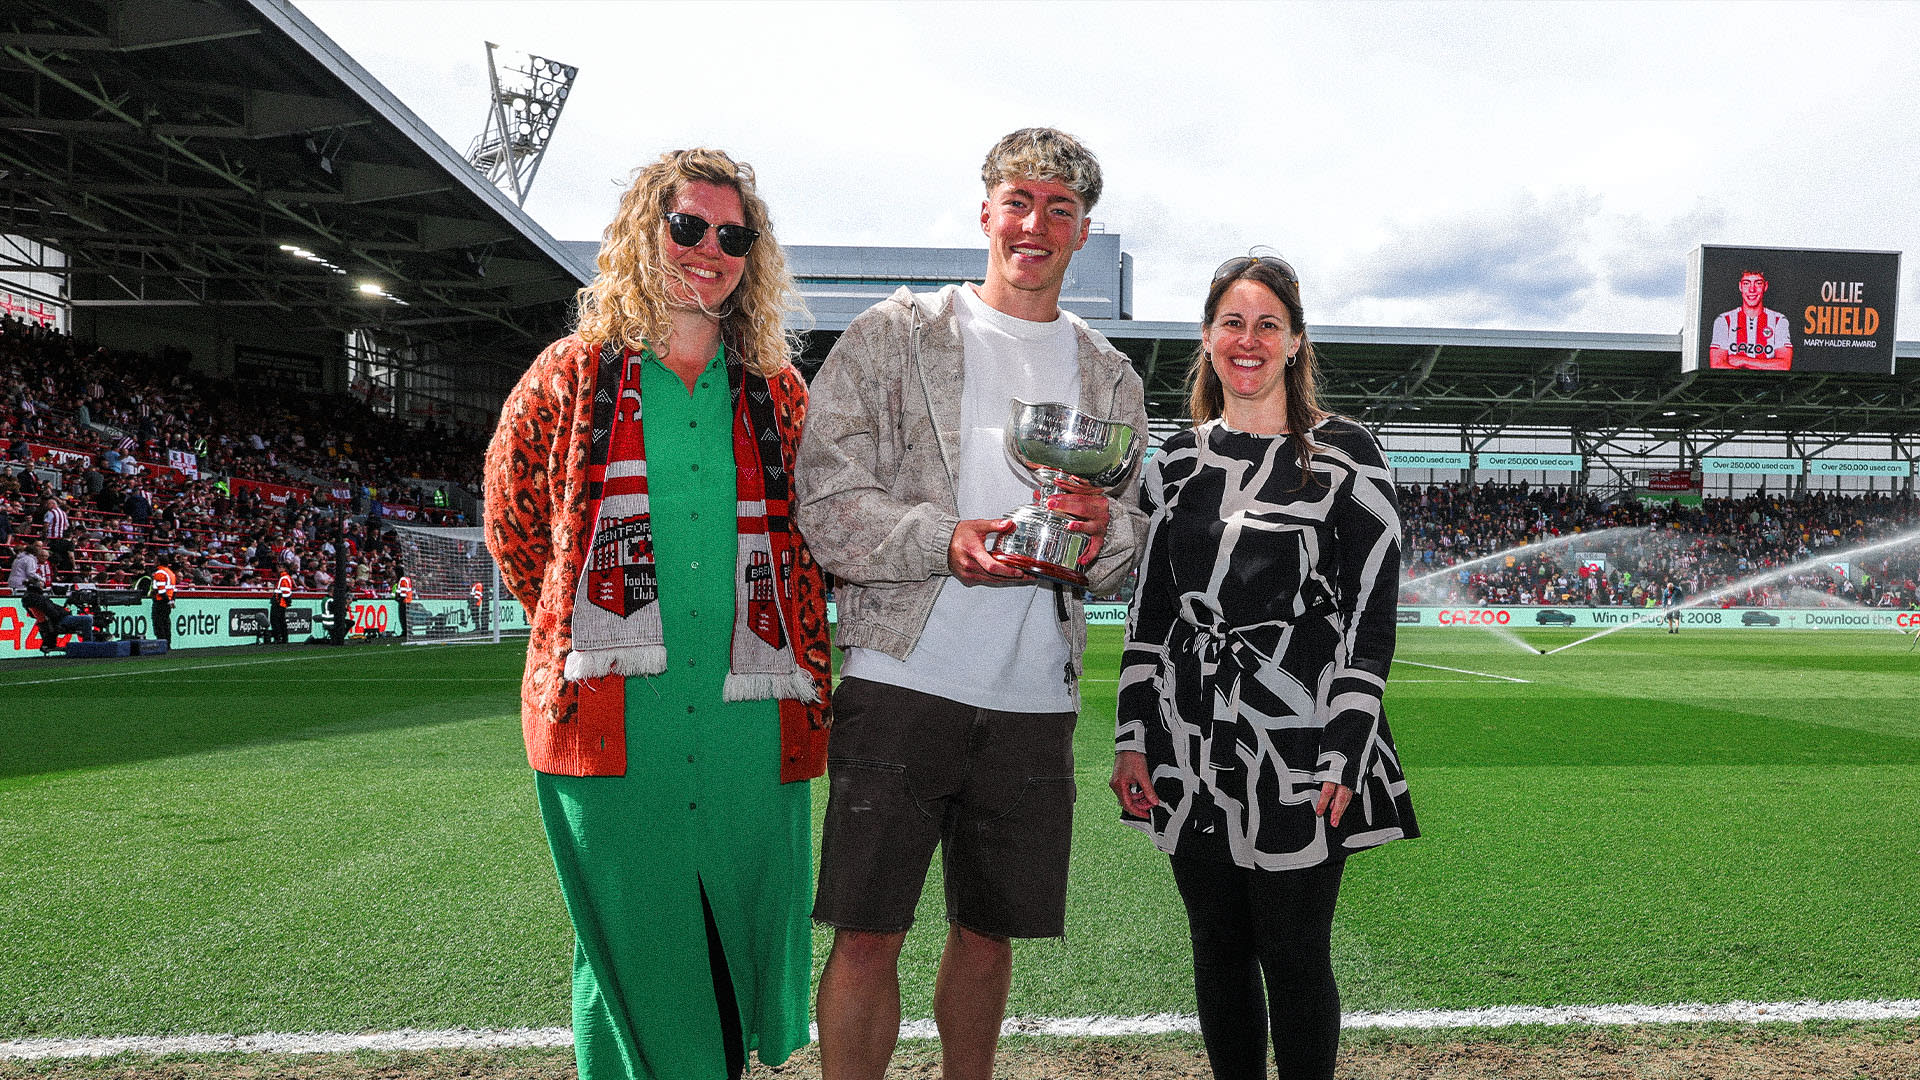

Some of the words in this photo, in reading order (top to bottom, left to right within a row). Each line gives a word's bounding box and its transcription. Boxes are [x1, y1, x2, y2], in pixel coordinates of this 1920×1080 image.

[1821, 281, 1864, 303] OLLIE
[1804, 305, 1880, 336] SHIELD
[1729, 342, 1774, 355] CAZOO
[1803, 339, 1825, 347] MARY
[1825, 339, 1851, 348] HALDER
[1851, 340, 1877, 348] AWARD
[1393, 455, 1425, 464] 250,000
[1426, 456, 1444, 464] used
[1489, 457, 1506, 465] Over
[1507, 457, 1538, 467] 250,000
[1539, 458, 1557, 466] used
[1712, 461, 1729, 469] Over
[1730, 462, 1760, 471] 250,000
[1821, 463, 1837, 471] Over
[1838, 463, 1868, 472] 250,000
[1869, 464, 1886, 472] used
[633, 586, 655, 600] Club
[176, 610, 221, 636] enter
[1438, 609, 1511, 625] CAZOO
[1593, 612, 1618, 624] Win
[1620, 614, 1629, 624] a
[1687, 612, 1722, 624] 2008
[1805, 613, 1870, 625] Download
[1871, 614, 1893, 626] the
[240, 621, 252, 632] App
